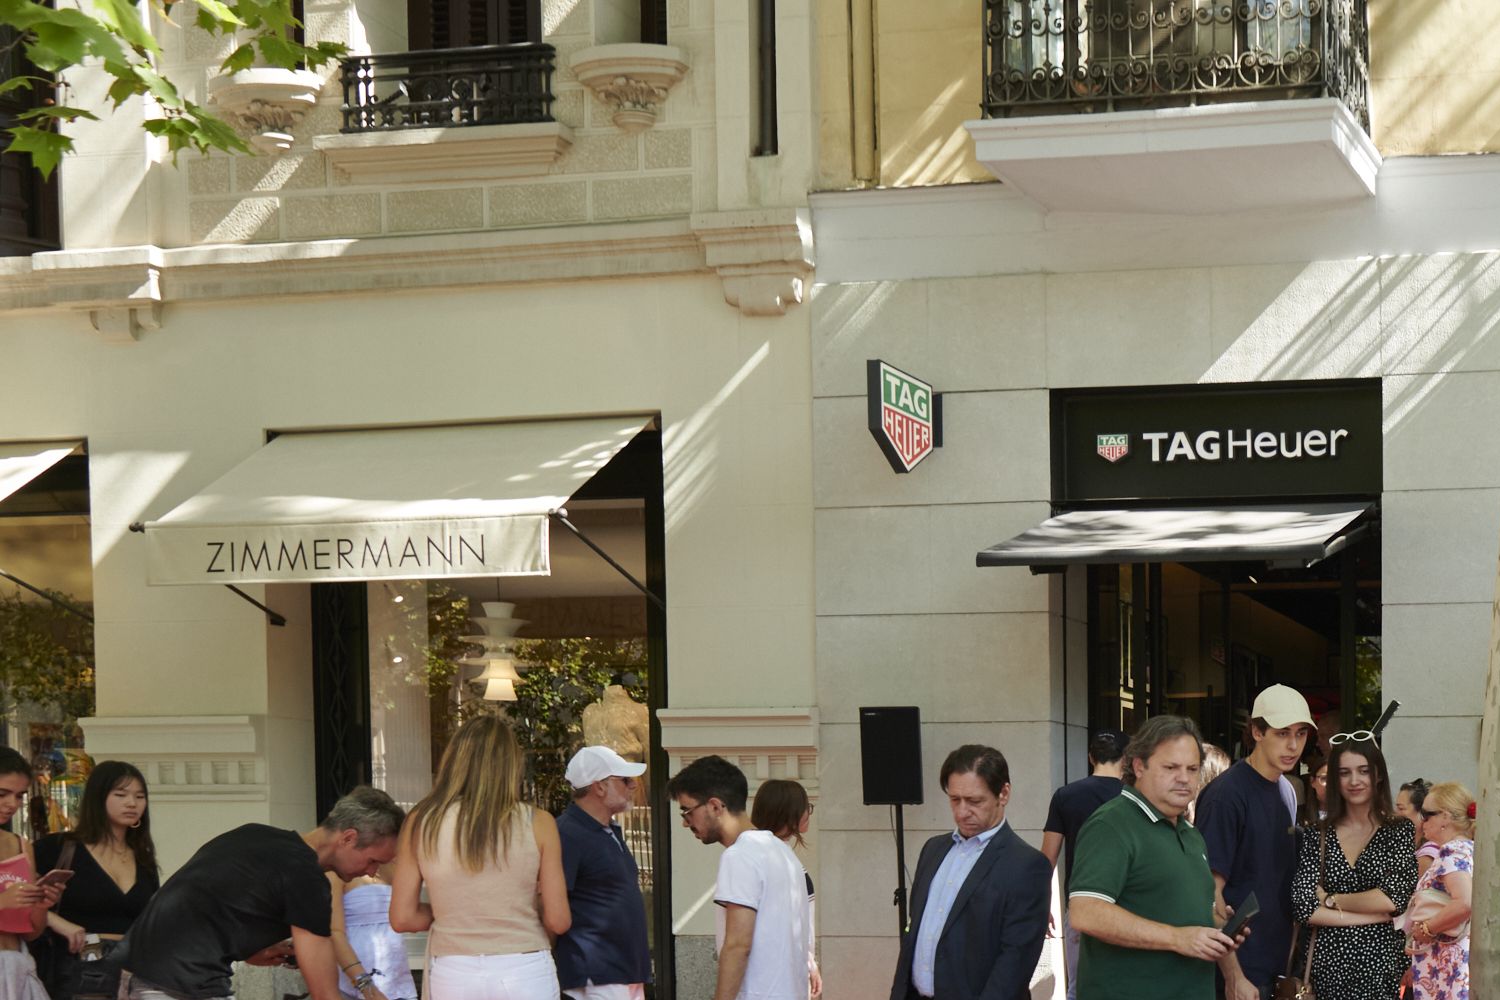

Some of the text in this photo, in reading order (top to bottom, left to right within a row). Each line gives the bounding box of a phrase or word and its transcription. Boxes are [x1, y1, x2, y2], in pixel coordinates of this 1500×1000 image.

[885, 373, 928, 419] TAG
[885, 408, 929, 462] HEUER
[1099, 446, 1127, 460] HEUER
[1100, 436, 1126, 445] TAG
[206, 534, 485, 573] ZIMMERMANN
